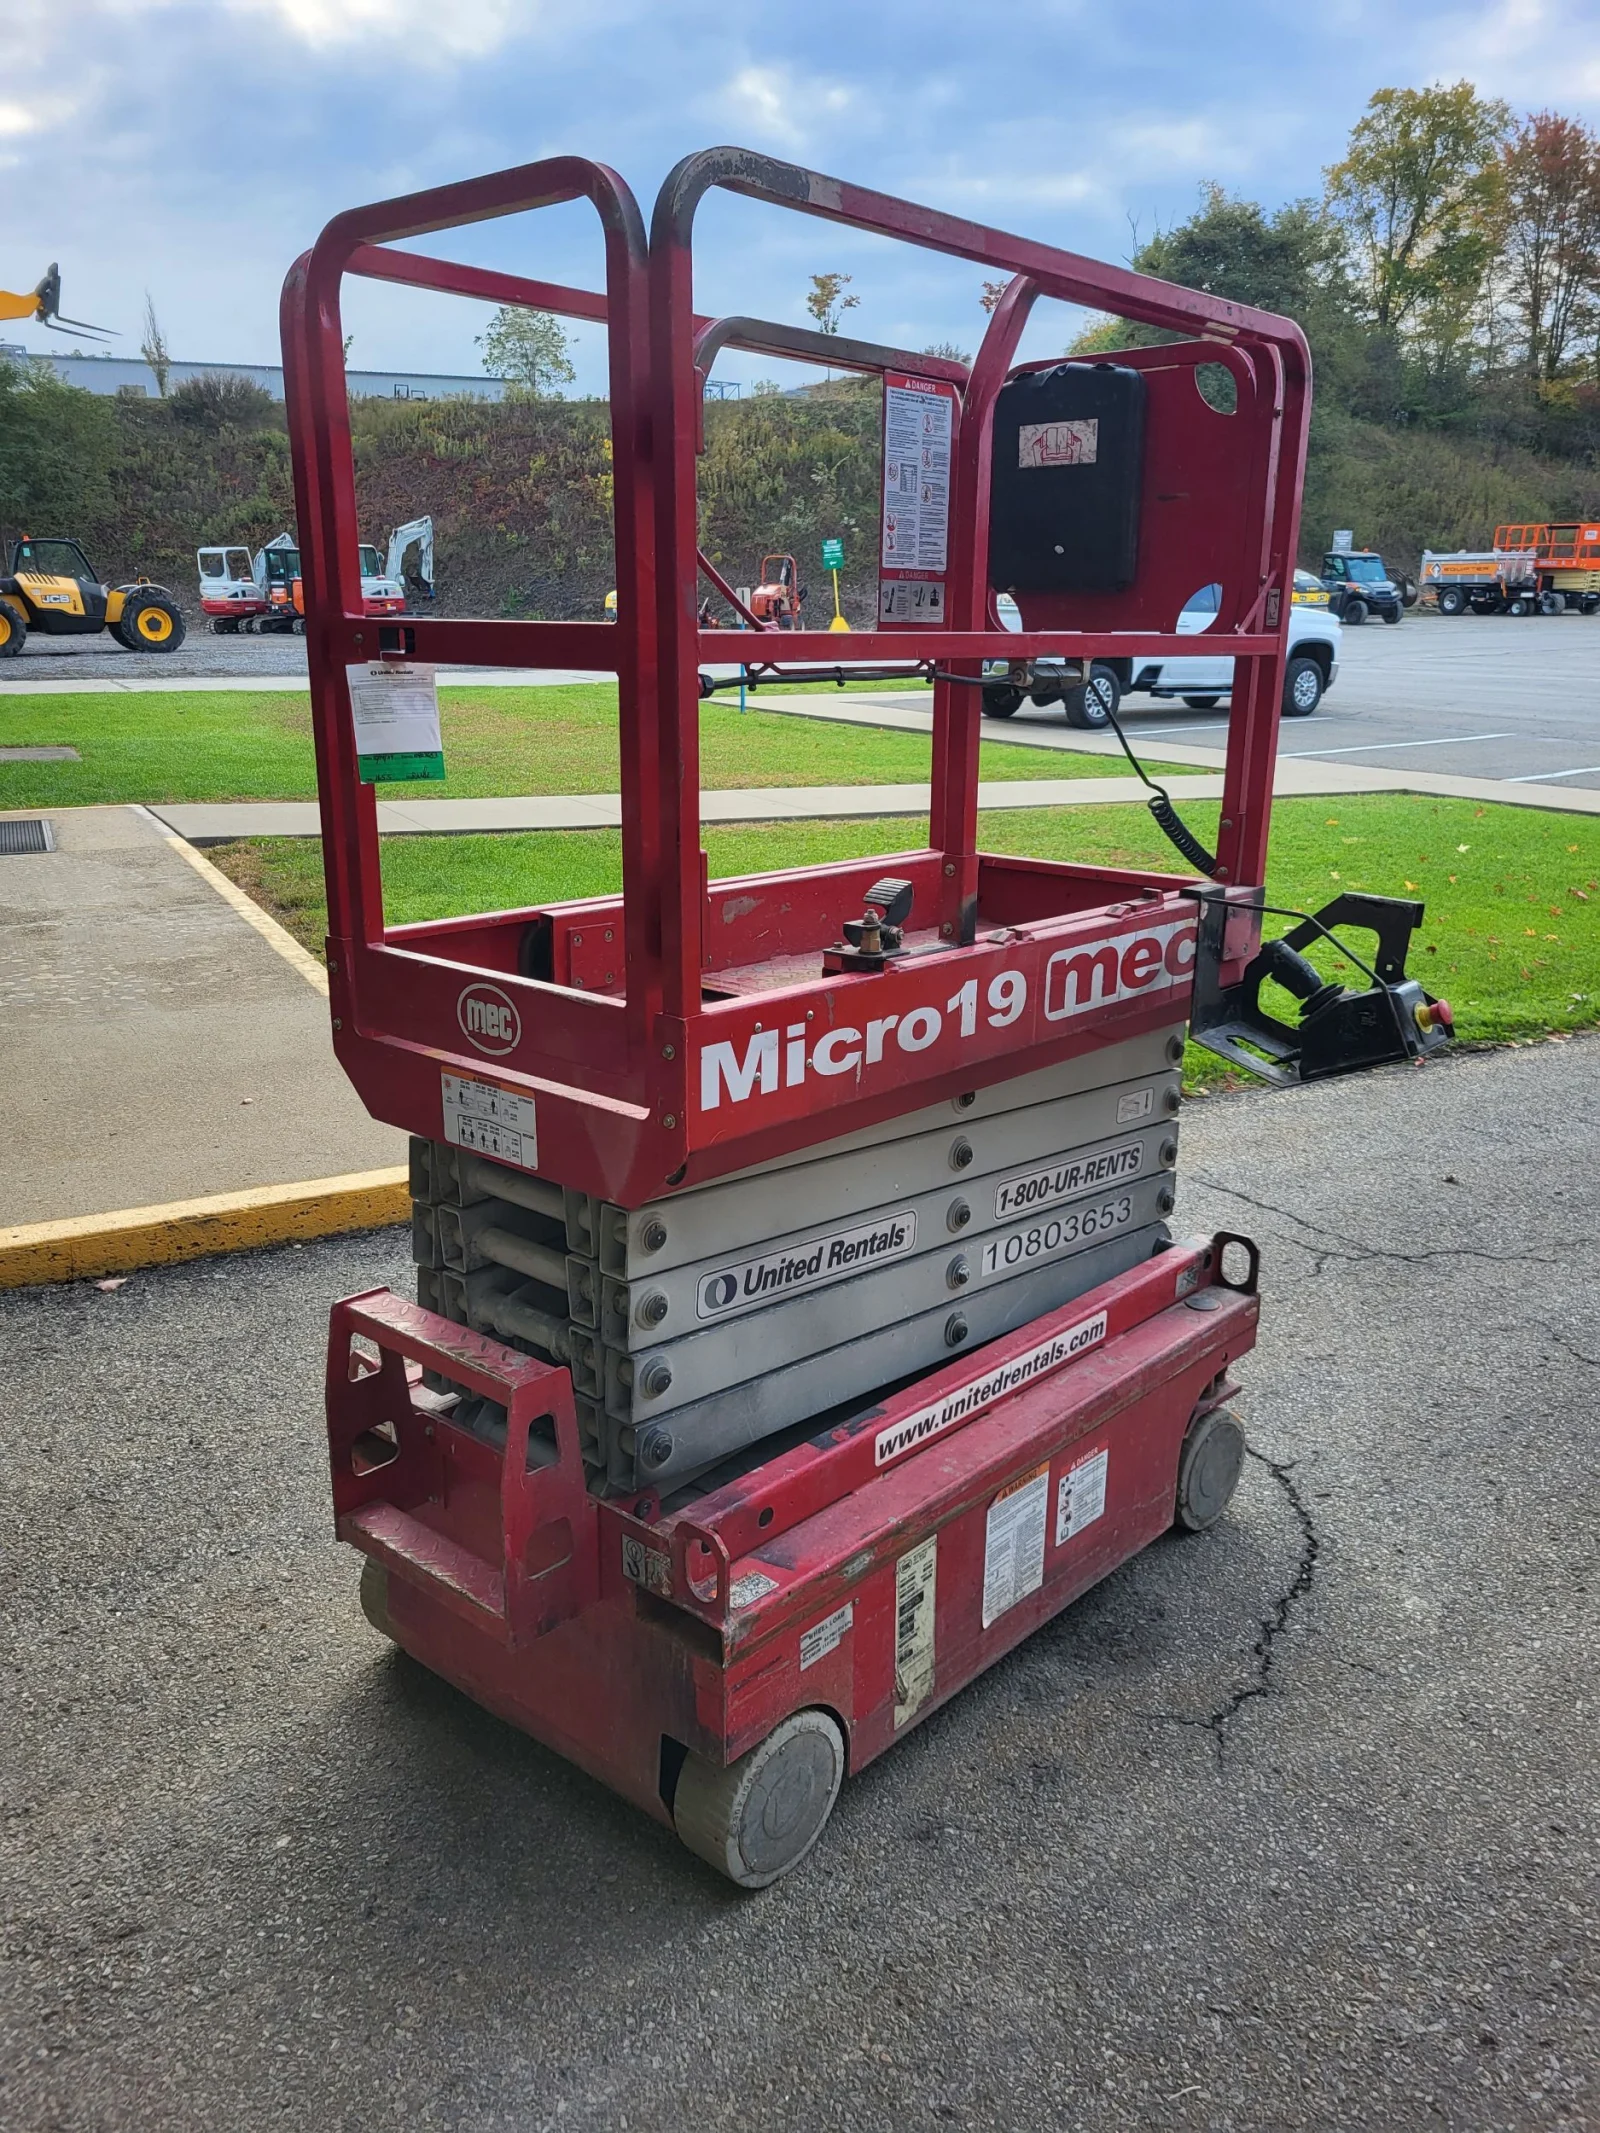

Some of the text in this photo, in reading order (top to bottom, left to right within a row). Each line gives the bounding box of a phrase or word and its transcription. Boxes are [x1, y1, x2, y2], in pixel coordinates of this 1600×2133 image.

[911, 380, 936, 393] DANGER
[905, 571, 929, 579] DANGER
[42, 594, 70, 603] JCB
[1000, 1147, 1141, 1212] 1-800-UR-RENTS
[986, 1196, 1132, 1271] 10803653
[743, 1223, 905, 1296] United Rentals
[878, 1320, 1105, 1460] www.unitedrentals.com
[1076, 1446, 1098, 1466] DANGER
